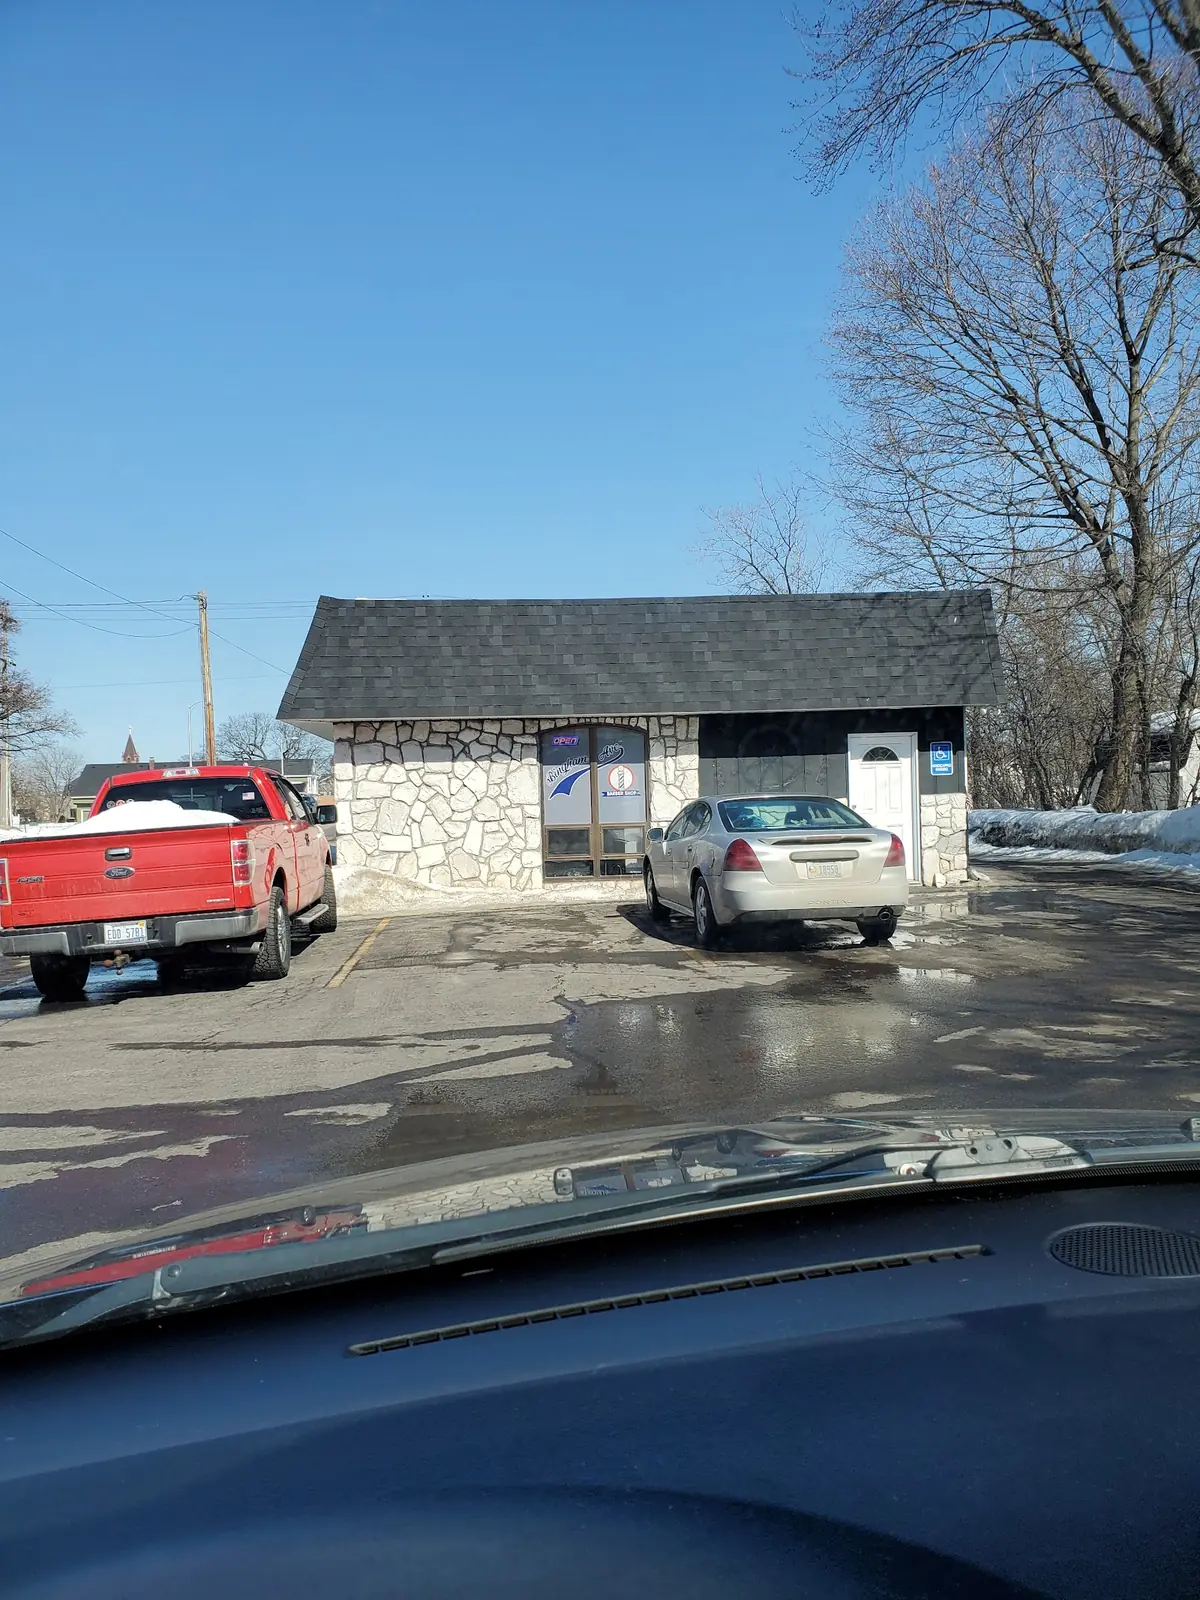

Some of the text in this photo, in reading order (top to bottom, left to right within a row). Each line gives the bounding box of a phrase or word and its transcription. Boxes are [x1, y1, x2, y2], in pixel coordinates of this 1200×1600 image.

[553, 736, 578, 745] OPEN
[546, 756, 589, 783] Bingham
[109, 868, 128, 877] Ford
